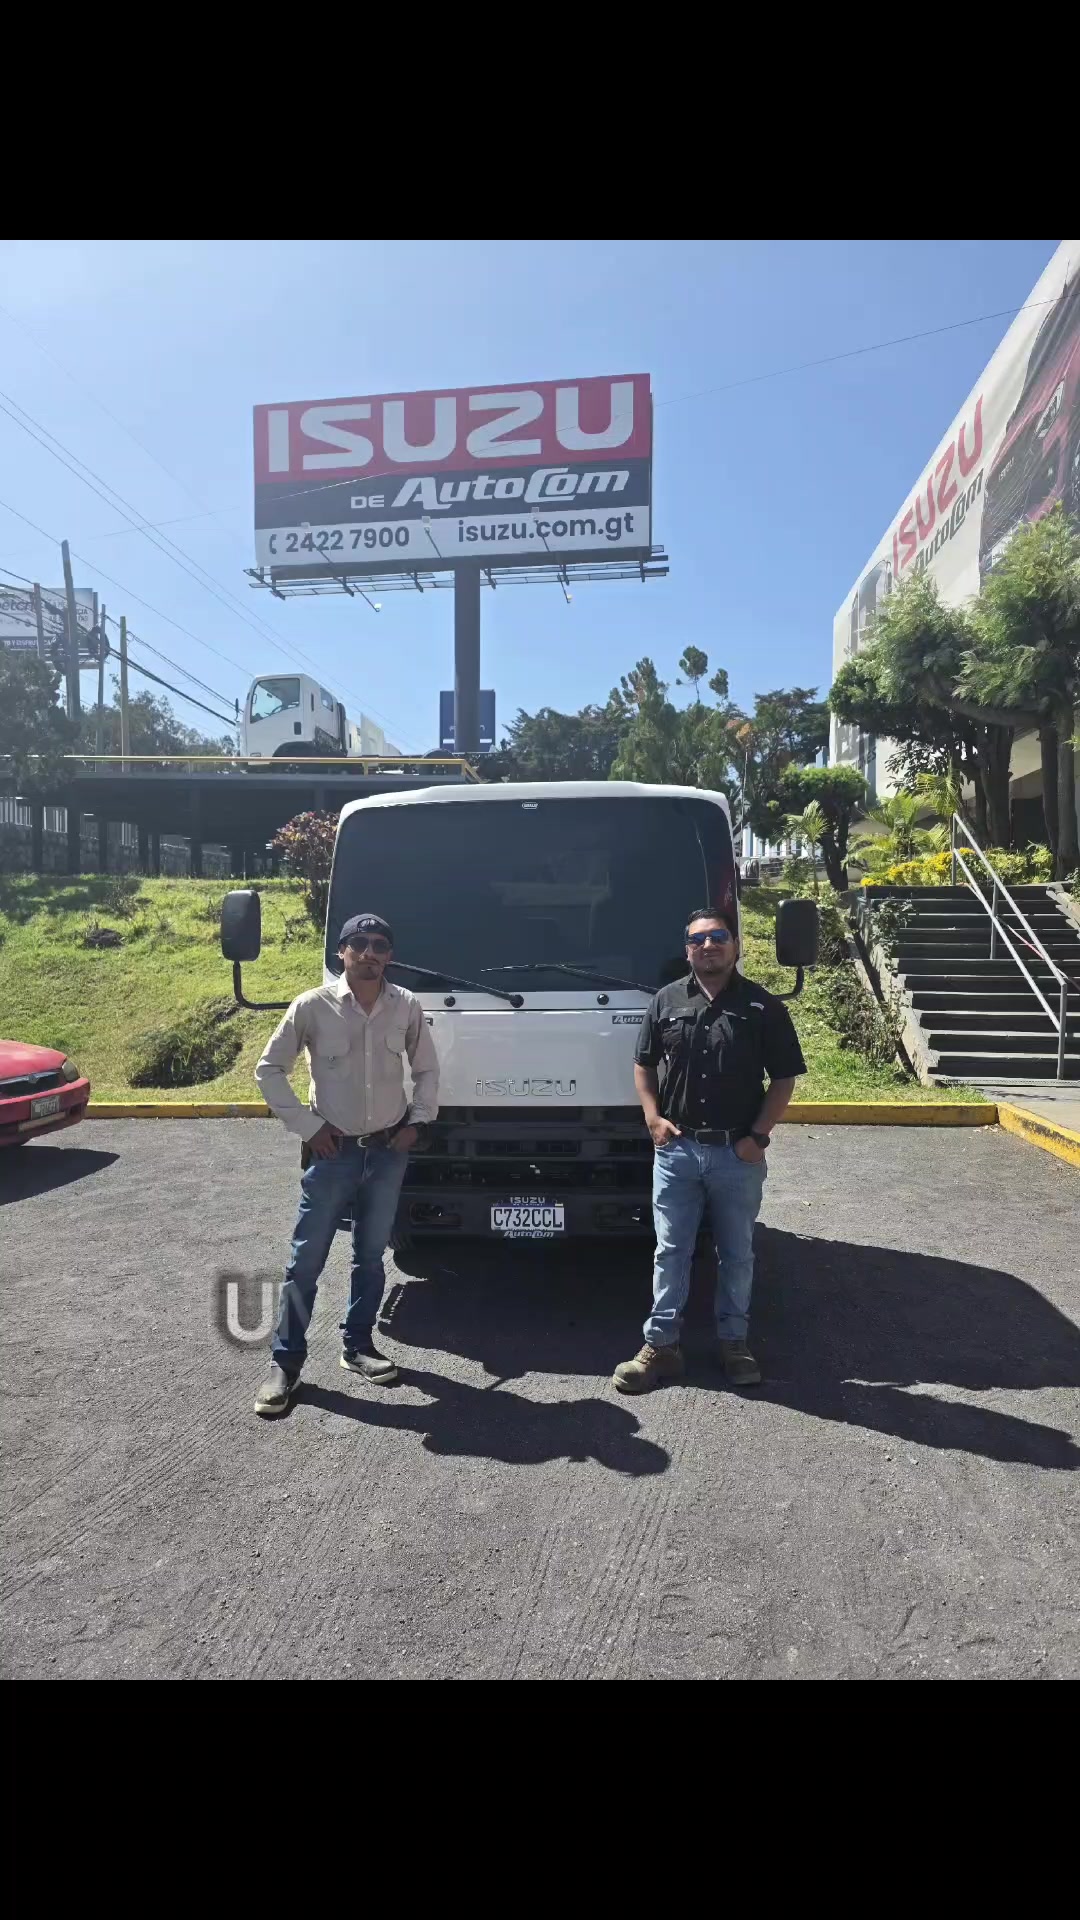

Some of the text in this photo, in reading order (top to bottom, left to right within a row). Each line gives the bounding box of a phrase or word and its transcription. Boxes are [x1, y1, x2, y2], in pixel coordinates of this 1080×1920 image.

[268, 381, 634, 473] ISUZU
[350, 467, 630, 510] DE AutoCom
[892, 394, 984, 577] ISUZU
[458, 512, 635, 543] isuzu.com.gt
[914, 467, 984, 575] AutoCom
[285, 526, 410, 552] 2422 7900
[613, 1015, 644, 1024] Auto
[476, 1079, 577, 1097] ISUZU
[510, 1196, 546, 1204] ISUZU
[493, 1208, 563, 1228] C732CCL
[504, 1230, 555, 1239] AutoCom
